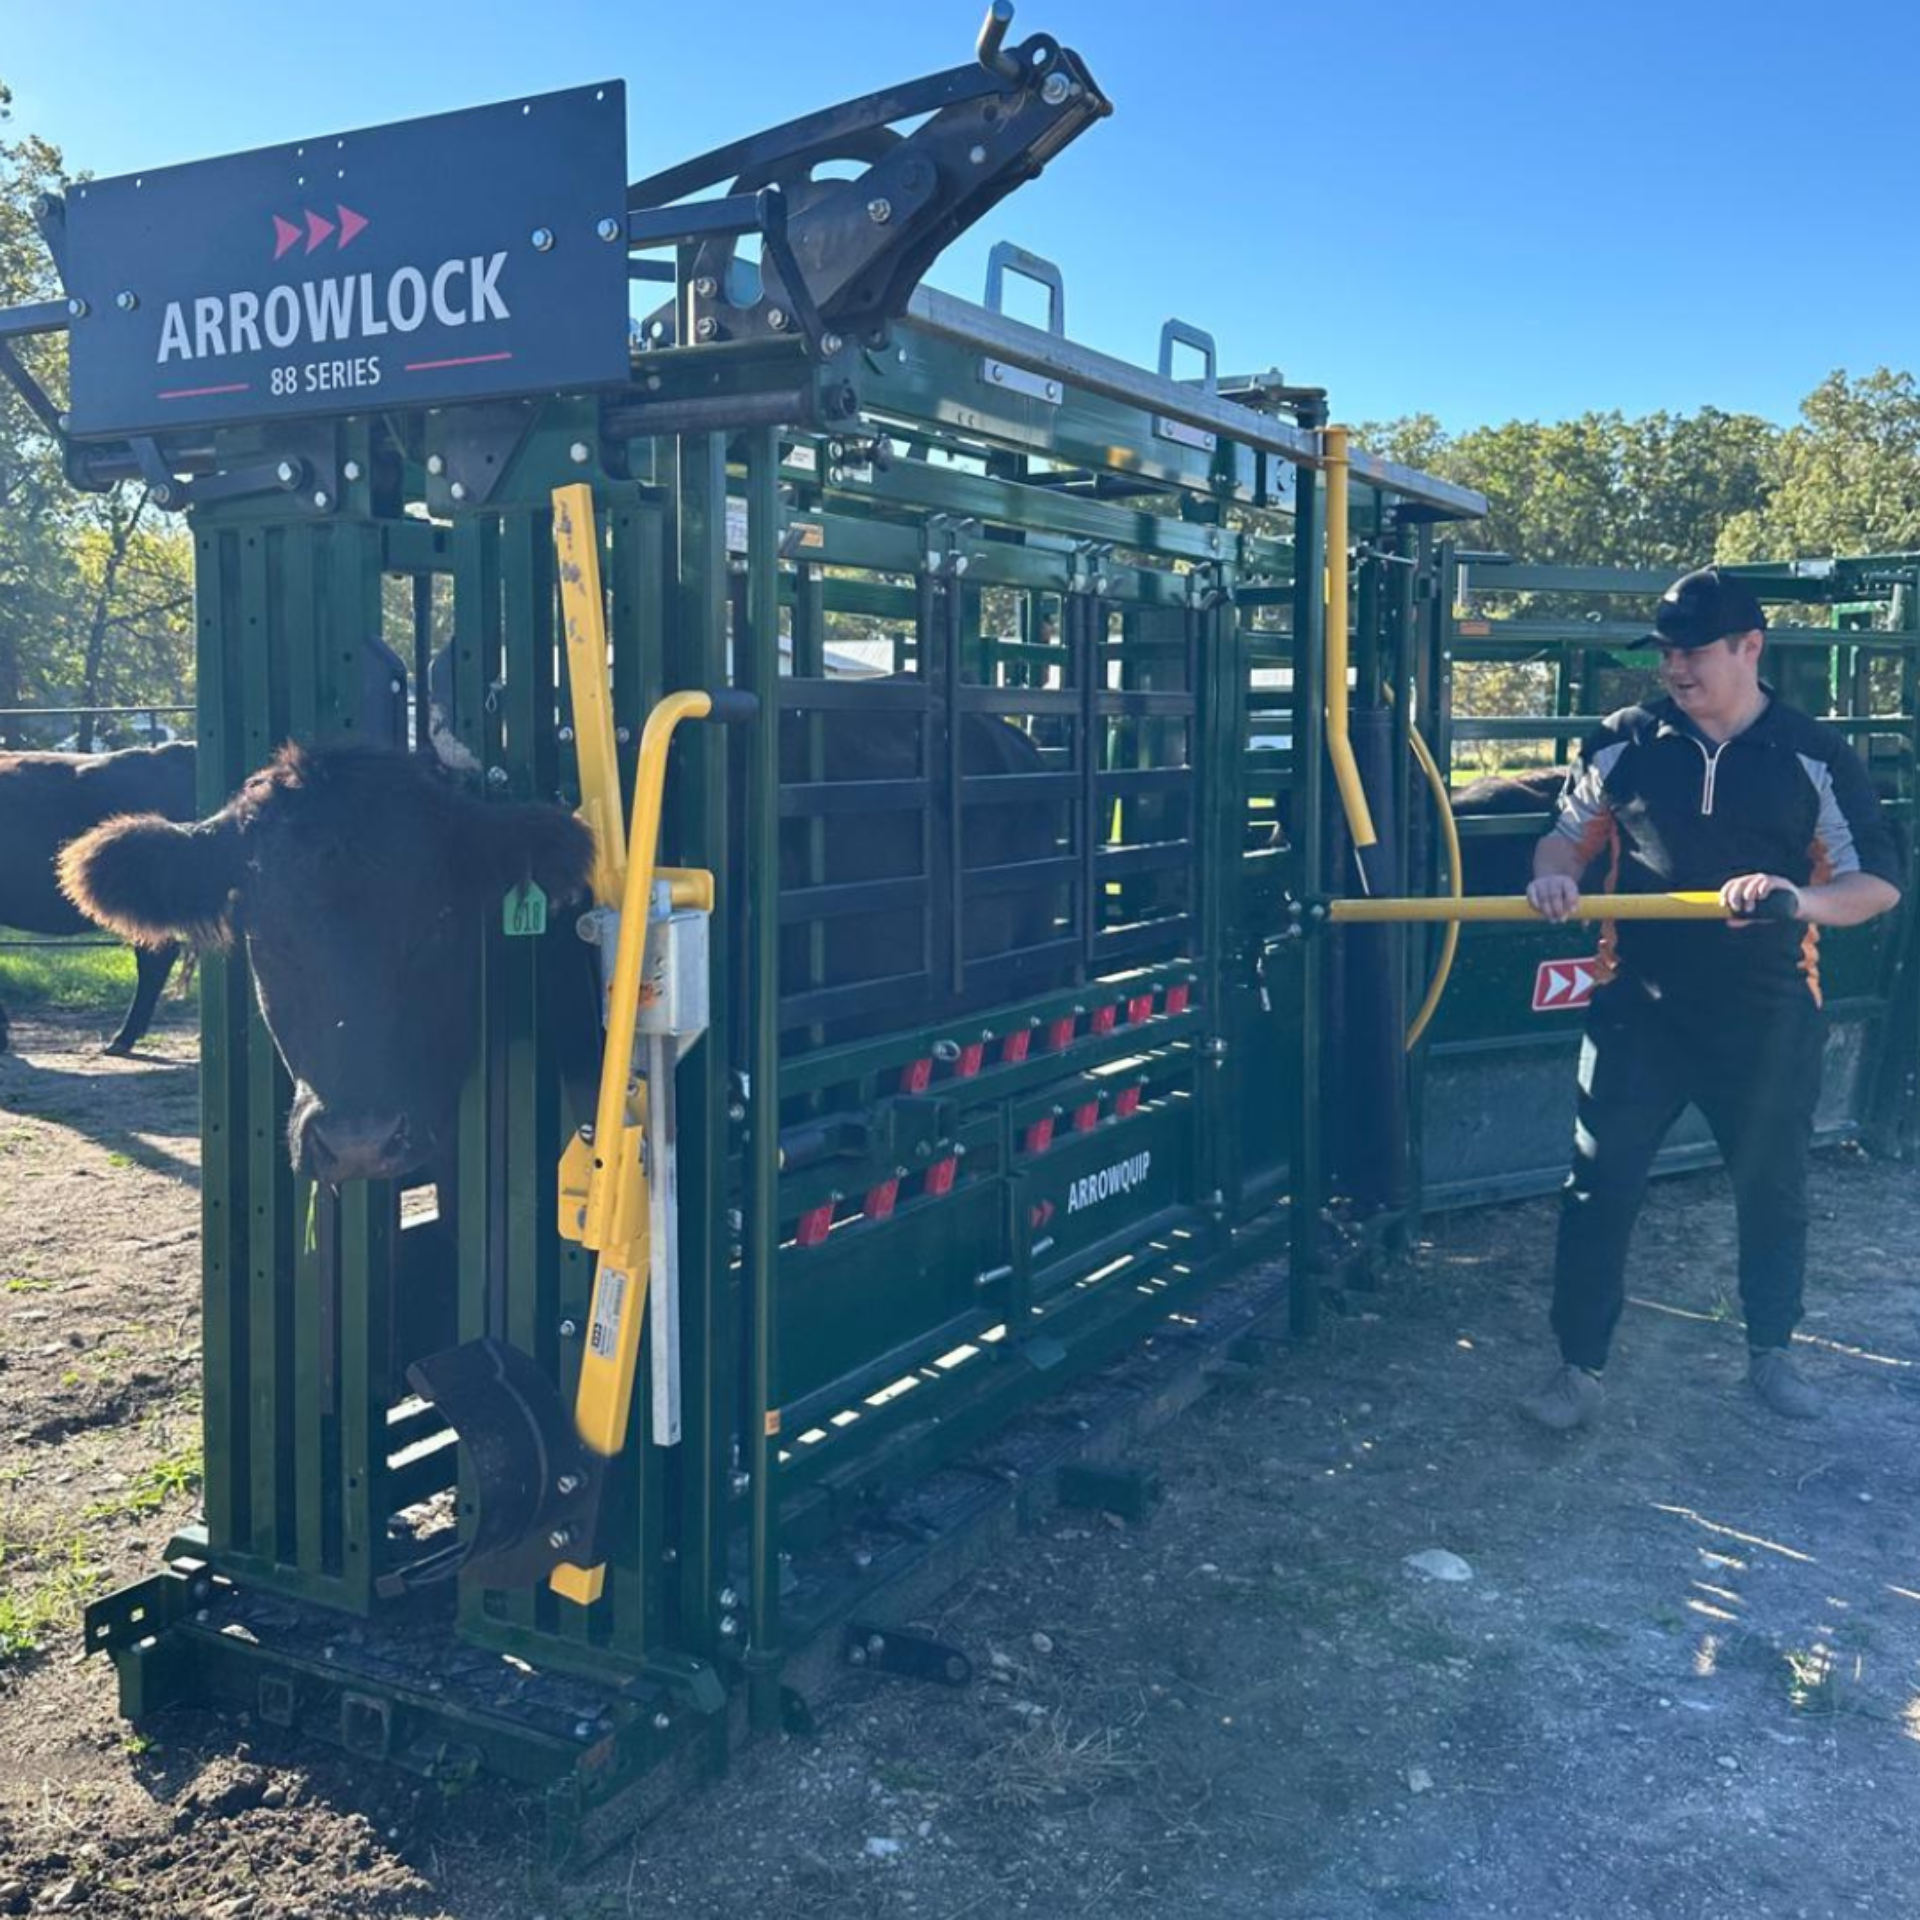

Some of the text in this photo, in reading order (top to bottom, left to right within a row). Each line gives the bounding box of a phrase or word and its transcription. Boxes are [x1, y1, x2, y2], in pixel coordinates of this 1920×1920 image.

[156, 252, 511, 364] ARROWLOCK
[270, 356, 382, 396] 88 SERIES
[1068, 1150, 1151, 1215] ARROWQUIP
